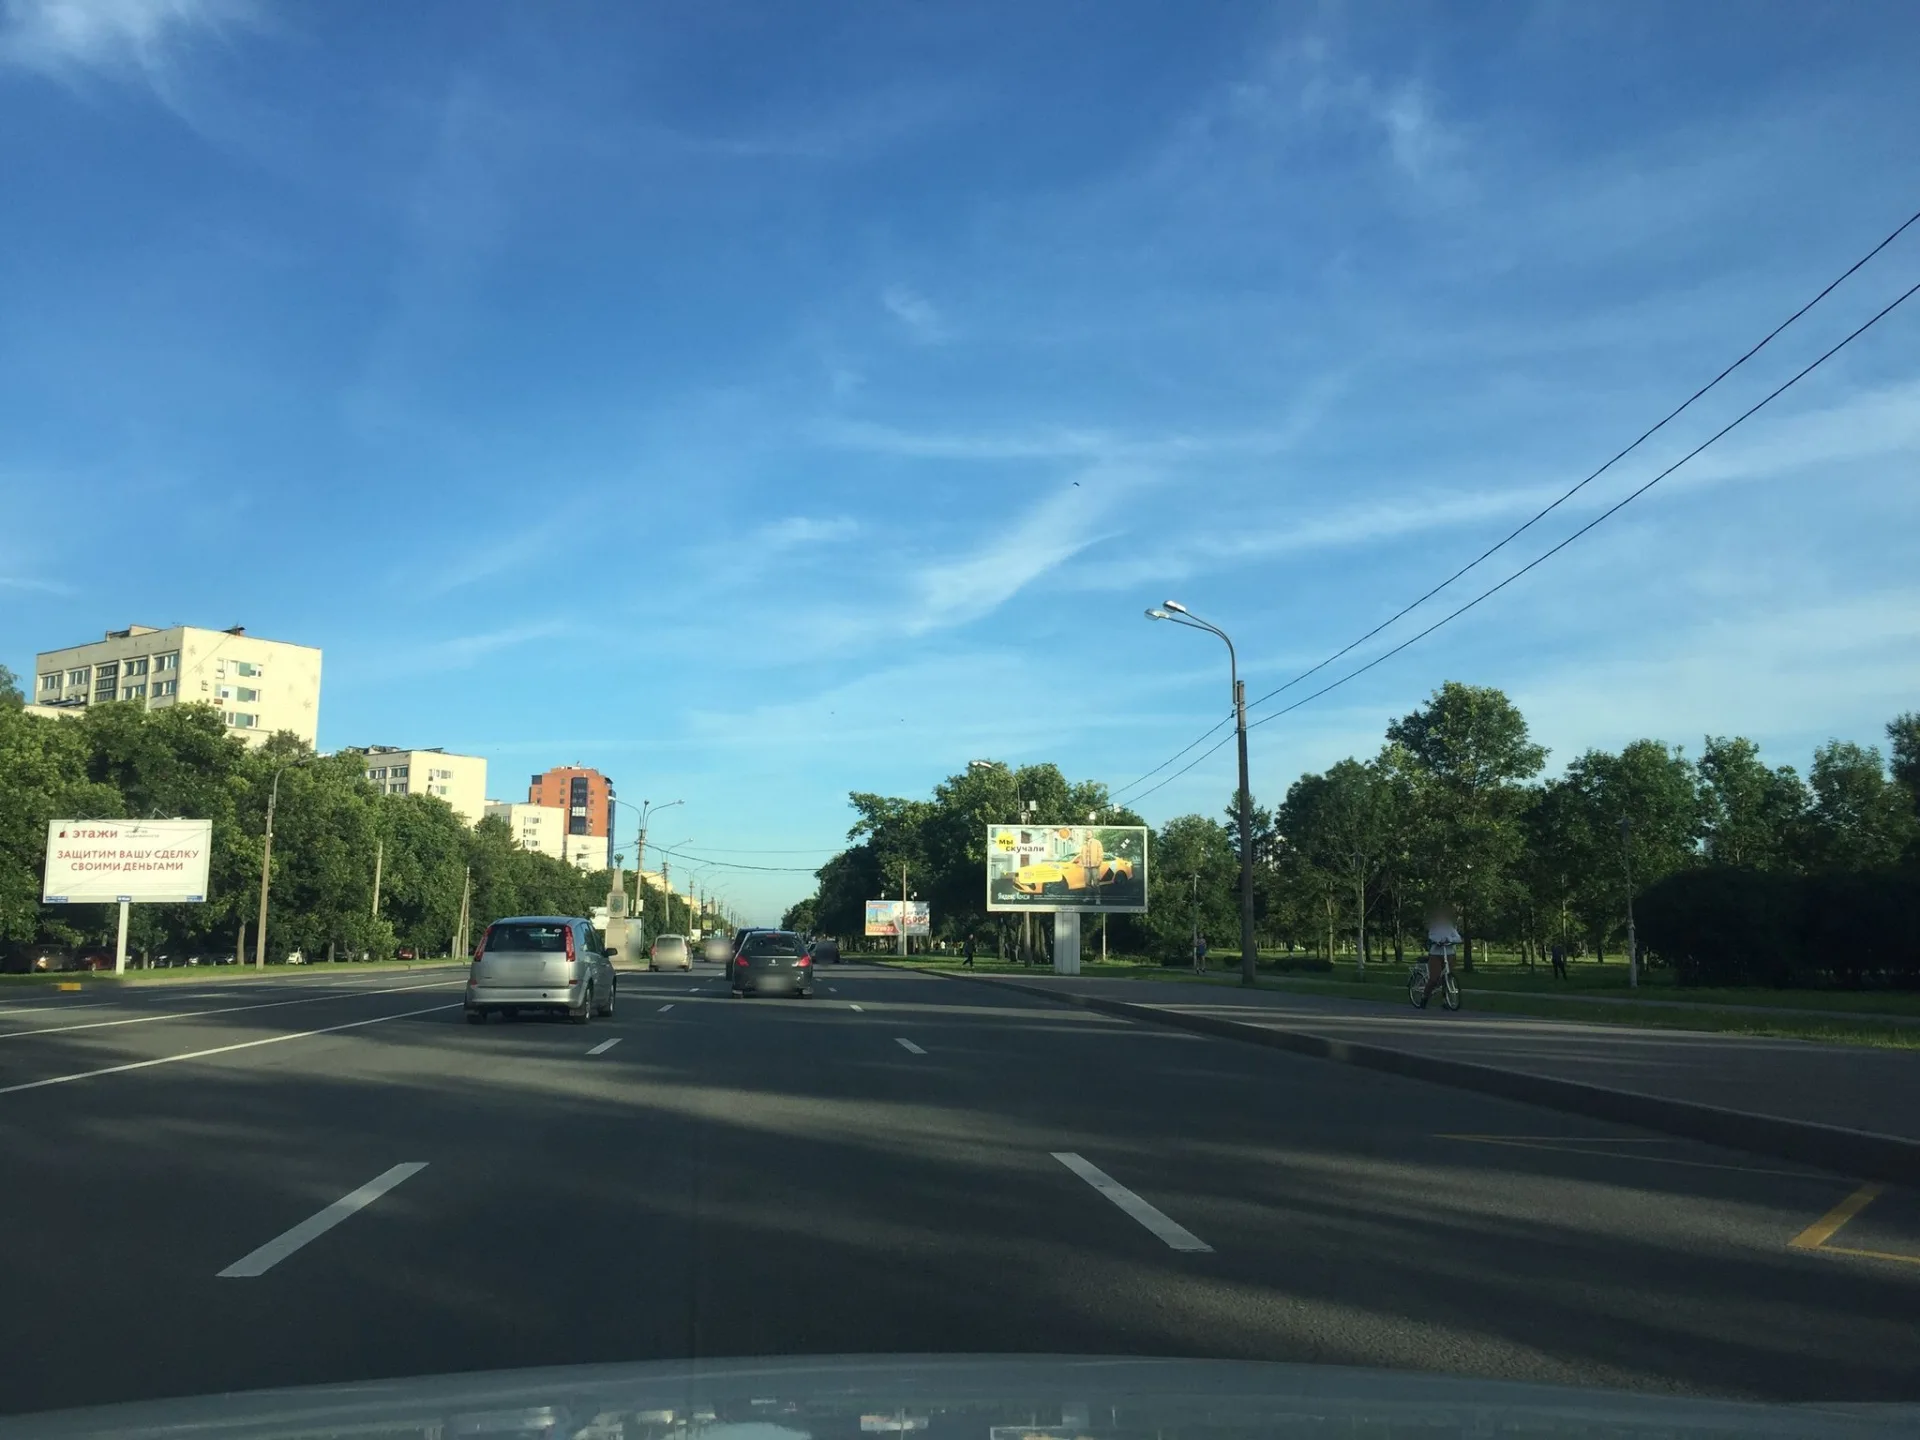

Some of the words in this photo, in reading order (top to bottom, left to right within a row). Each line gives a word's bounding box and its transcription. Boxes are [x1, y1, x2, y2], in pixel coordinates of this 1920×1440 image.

[72, 830, 118, 839] этажи
[57, 850, 116, 860] ЗАЩИТИМ
[119, 850, 152, 859] ВАШУ
[154, 850, 199, 859] СДЕЛКУ
[71, 862, 120, 871] СВОИМИ
[122, 862, 183, 872] ДЕНЬГАМИ
